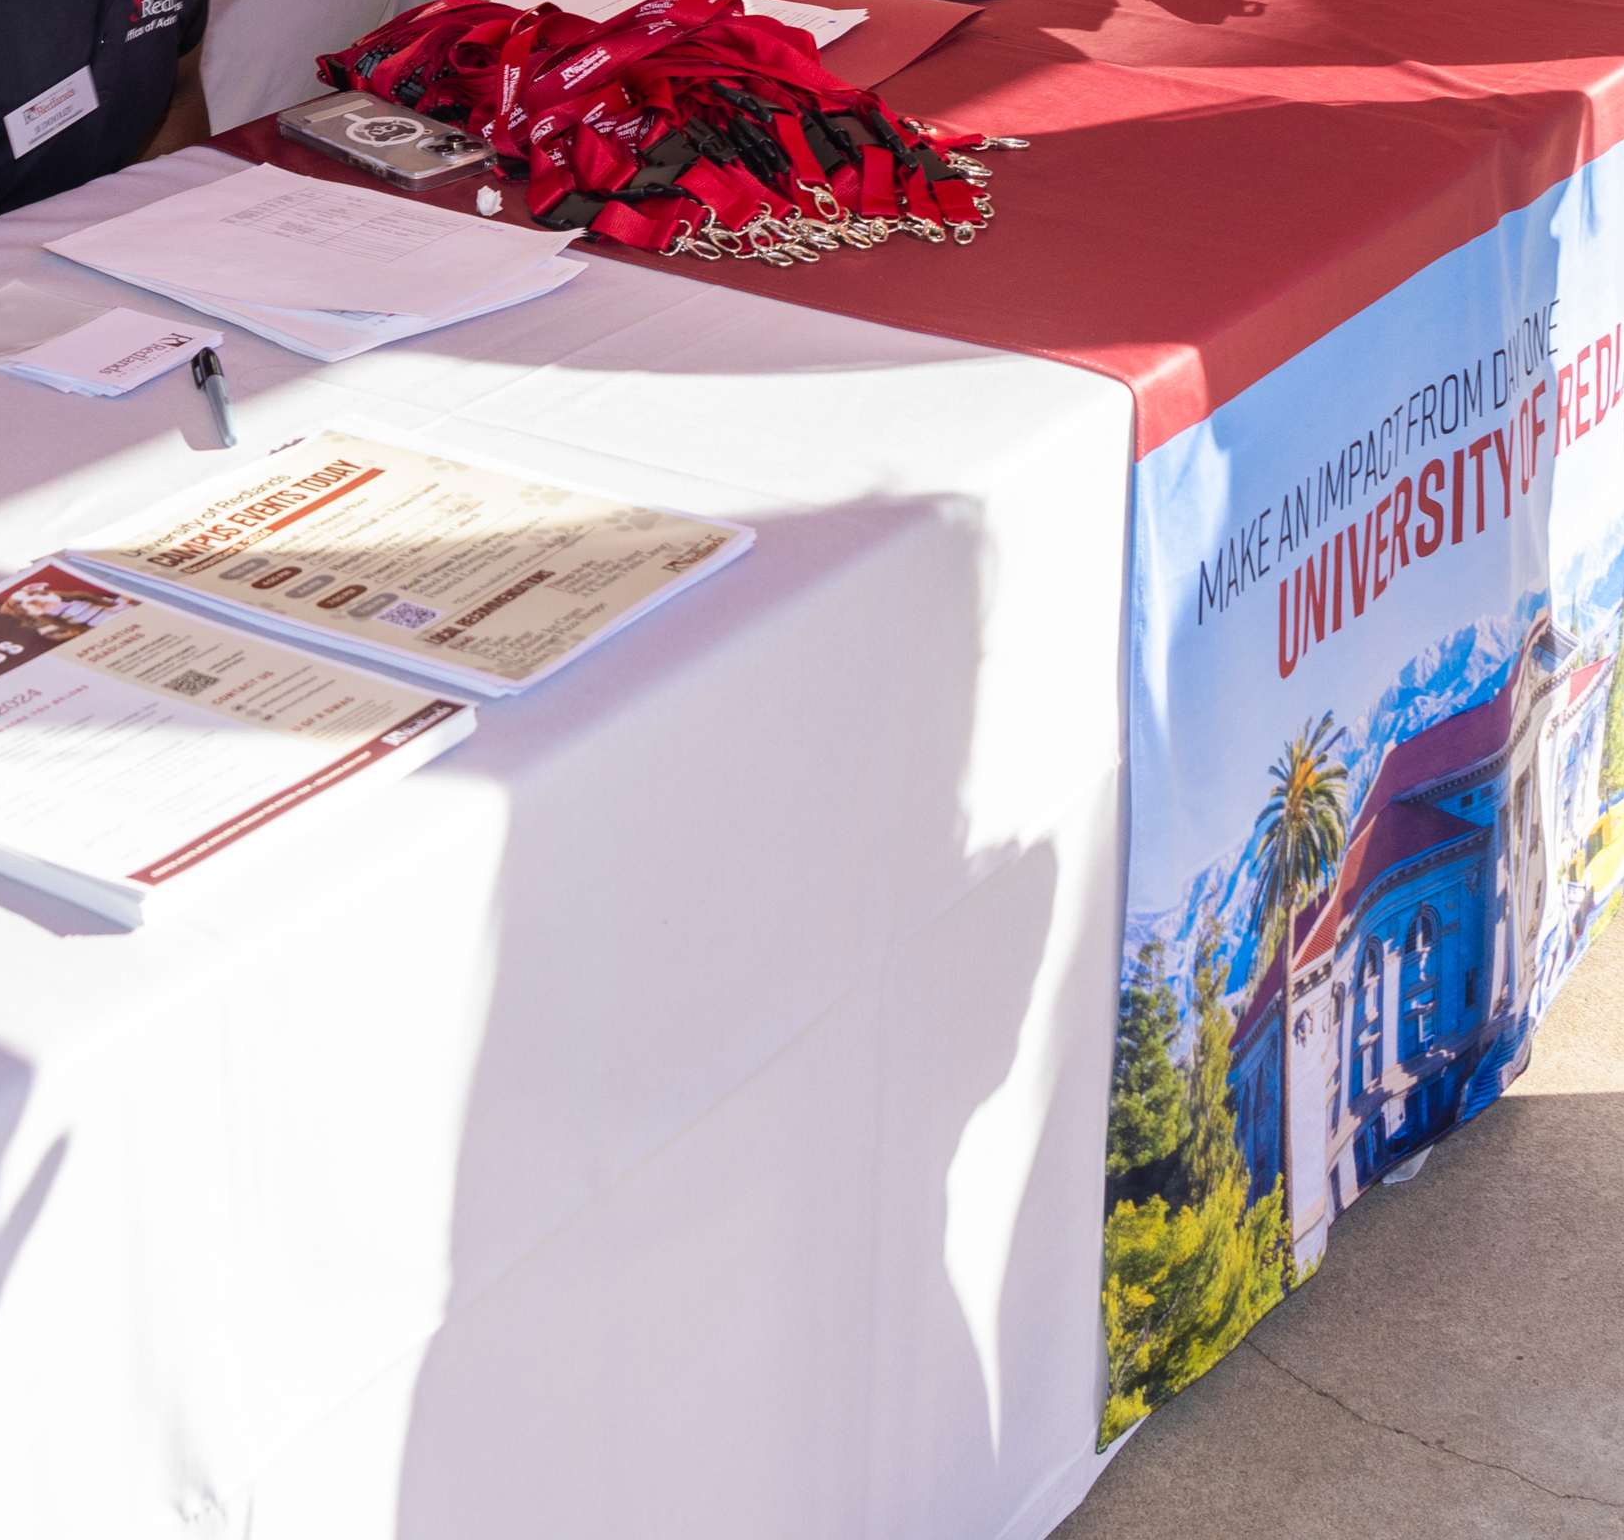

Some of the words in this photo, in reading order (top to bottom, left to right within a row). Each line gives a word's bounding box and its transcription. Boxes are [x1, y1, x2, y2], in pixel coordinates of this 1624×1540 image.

[98, 342, 166, 376] Redlands
[143, 521, 246, 570] CAMPUS
[222, 487, 310, 528] EVENTS
[288, 458, 367, 493] TODAY
[199, 501, 222, 520] of
[211, 471, 294, 510] Redlands
[1197, 506, 1271, 626] MAKE
[1277, 482, 1311, 564] AN
[1316, 403, 1404, 530] IMPACT
[1405, 358, 1483, 456] FROM
[1493, 326, 1520, 410] DAY
[1521, 297, 1560, 377] ONE
[1277, 413, 1515, 680] UNIVERSITY
[1518, 378, 1547, 496] OF
